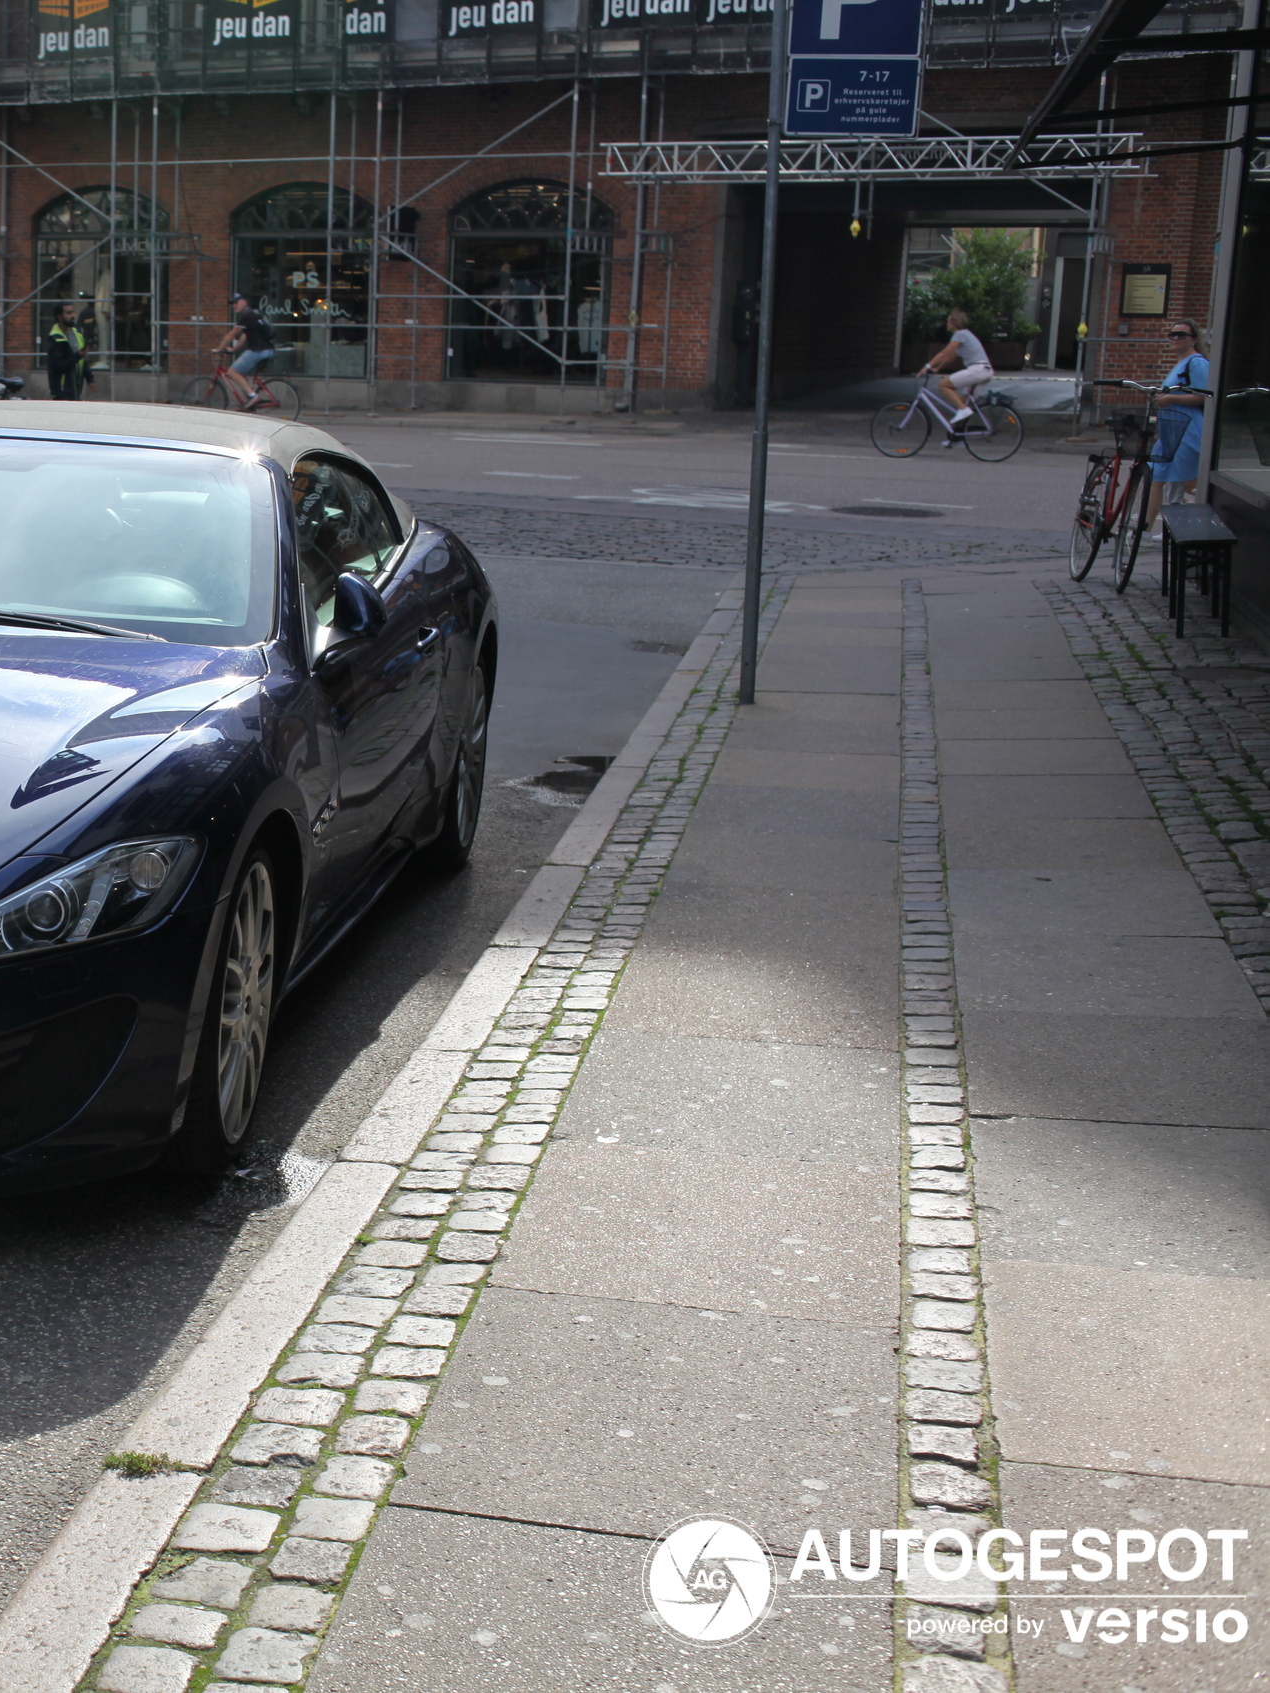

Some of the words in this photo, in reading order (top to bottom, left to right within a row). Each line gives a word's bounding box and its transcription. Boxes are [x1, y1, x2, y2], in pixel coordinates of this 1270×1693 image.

[345, 8, 386, 35] dan
[859, 71, 890, 82] 7-17
[804, 83, 824, 108] P
[843, 88, 890, 96] Reserveret
[892, 88, 902, 96] til
[834, 98, 910, 106] erhvervskøretøjer
[855, 106, 867, 114] på
[869, 107, 887, 115] gule
[292, 271, 320, 288] PS
